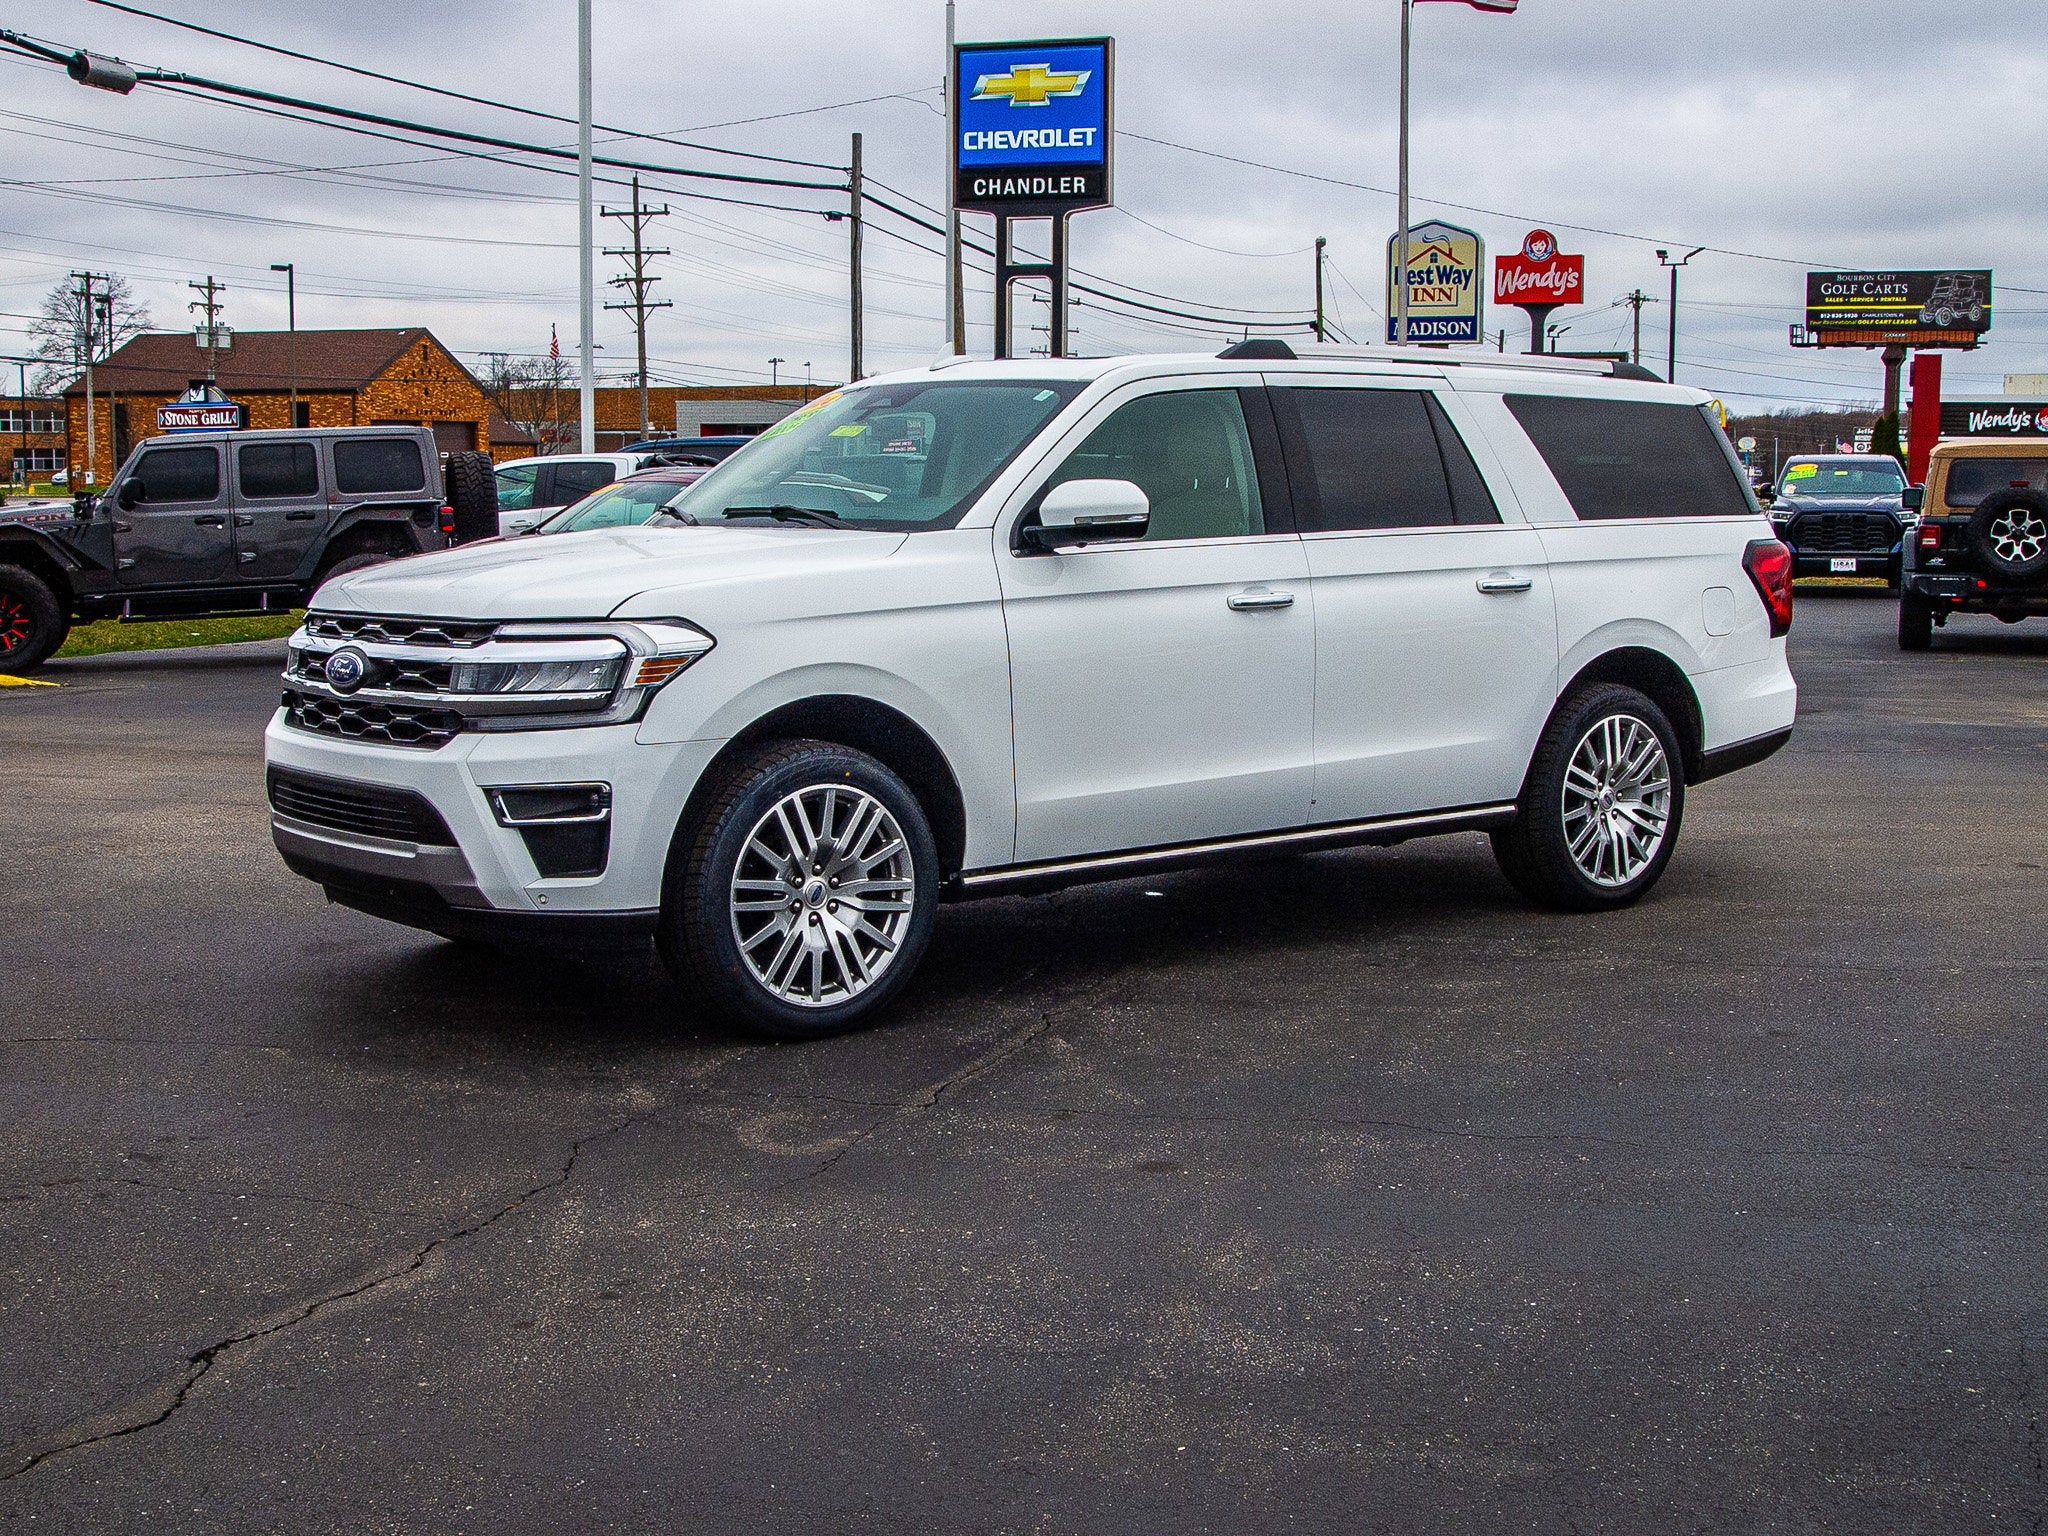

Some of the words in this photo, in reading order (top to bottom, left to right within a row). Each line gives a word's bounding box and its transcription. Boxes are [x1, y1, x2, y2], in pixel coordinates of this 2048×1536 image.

[963, 127, 1097, 150] CHEVROLET
[973, 176, 1086, 196] CHANDLER
[1435, 265, 1473, 291] Way
[1497, 261, 1579, 297] Wendy's
[1821, 282, 1858, 295] GOLF
[1863, 282, 1908, 295] CARTS
[1412, 287, 1454, 302] INN
[164, 411, 198, 426] STONE
[201, 411, 232, 425] GRILL
[1969, 406, 2032, 433] Wendy's
